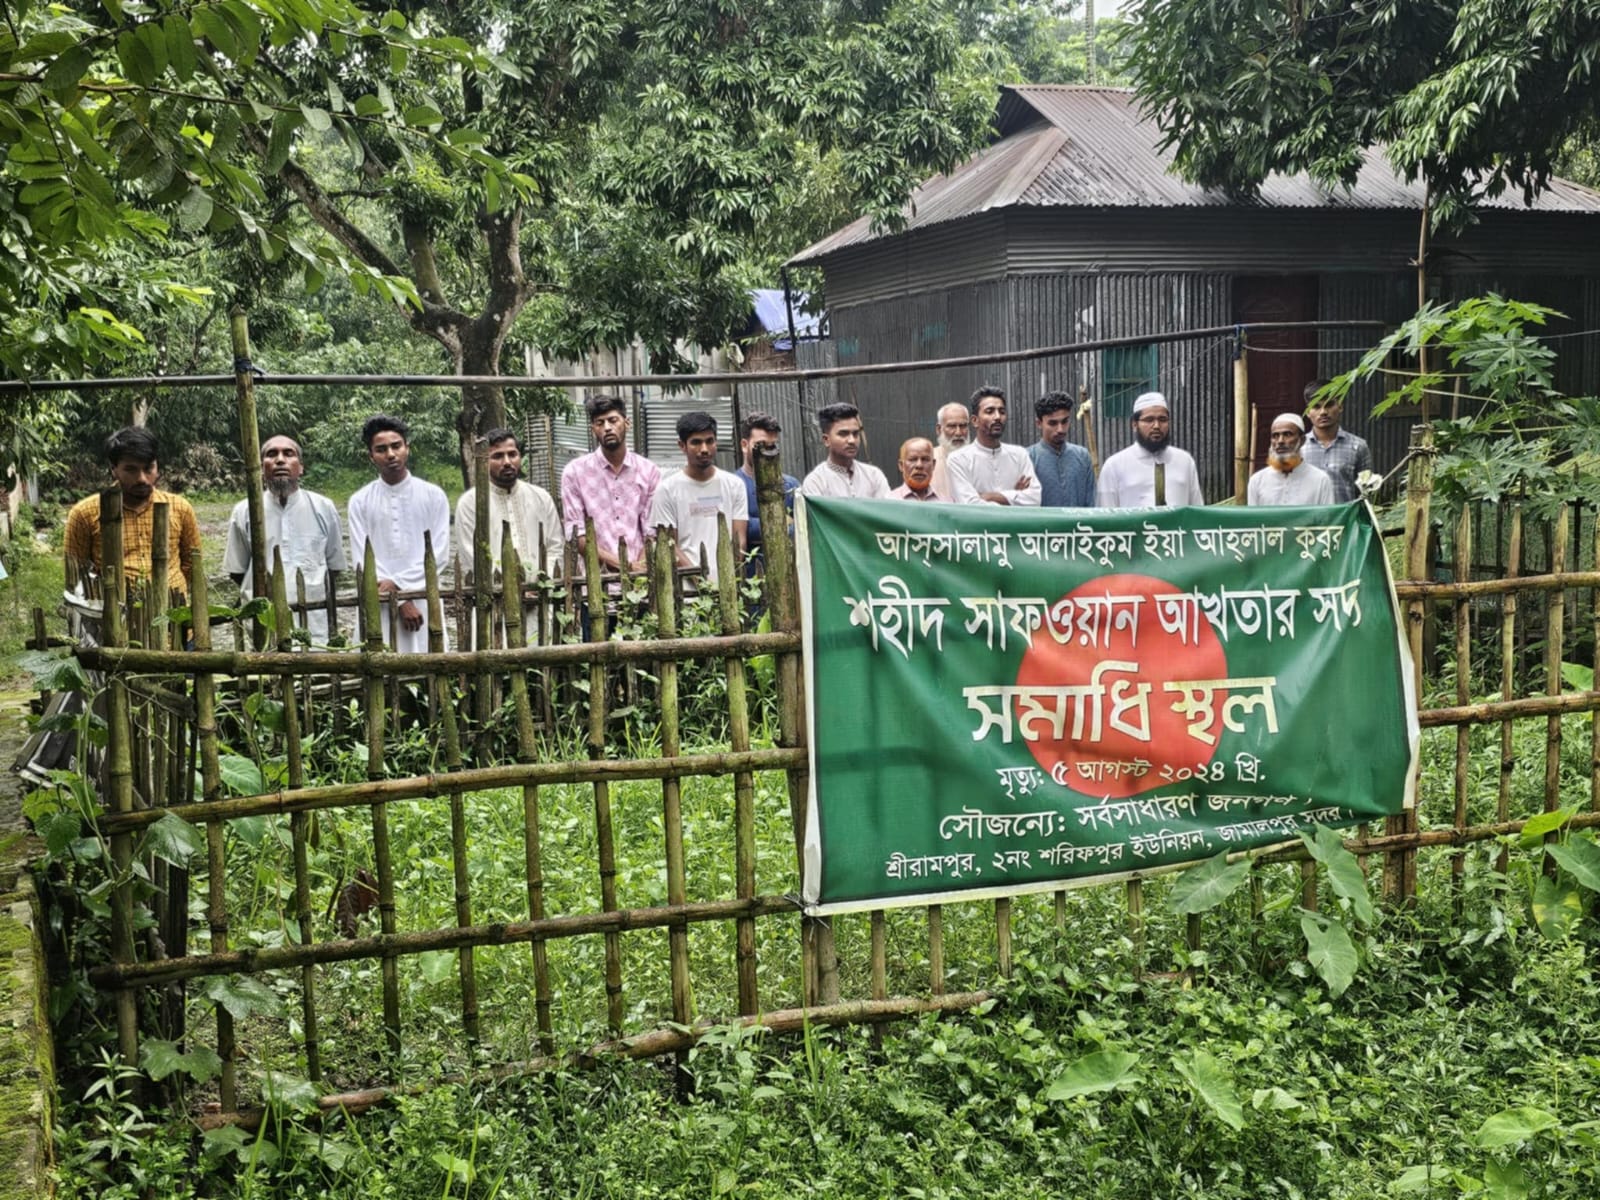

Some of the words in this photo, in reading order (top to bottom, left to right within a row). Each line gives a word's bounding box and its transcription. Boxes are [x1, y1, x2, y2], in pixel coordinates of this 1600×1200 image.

[1017, 522, 1136, 568] আলাইকুম
[1142, 521, 1187, 561] ইয়া
[842, 574, 951, 661] শহীদ
[960, 590, 1147, 651] সাফওয়ান
[1153, 583, 1302, 646] আখতার
[962, 660, 1152, 744] সমাধি
[1163, 676, 1279, 746] স্থল
[1051, 761, 1069, 786] ৫
[1076, 757, 1153, 783] আগস্ট
[1159, 761, 1226, 783] ২০২৪
[1073, 792, 1200, 831] সর্বসাধারণ
[1038, 842, 1126, 866] শরিফপুর
[1214, 814, 1300, 842] জামালপুর
